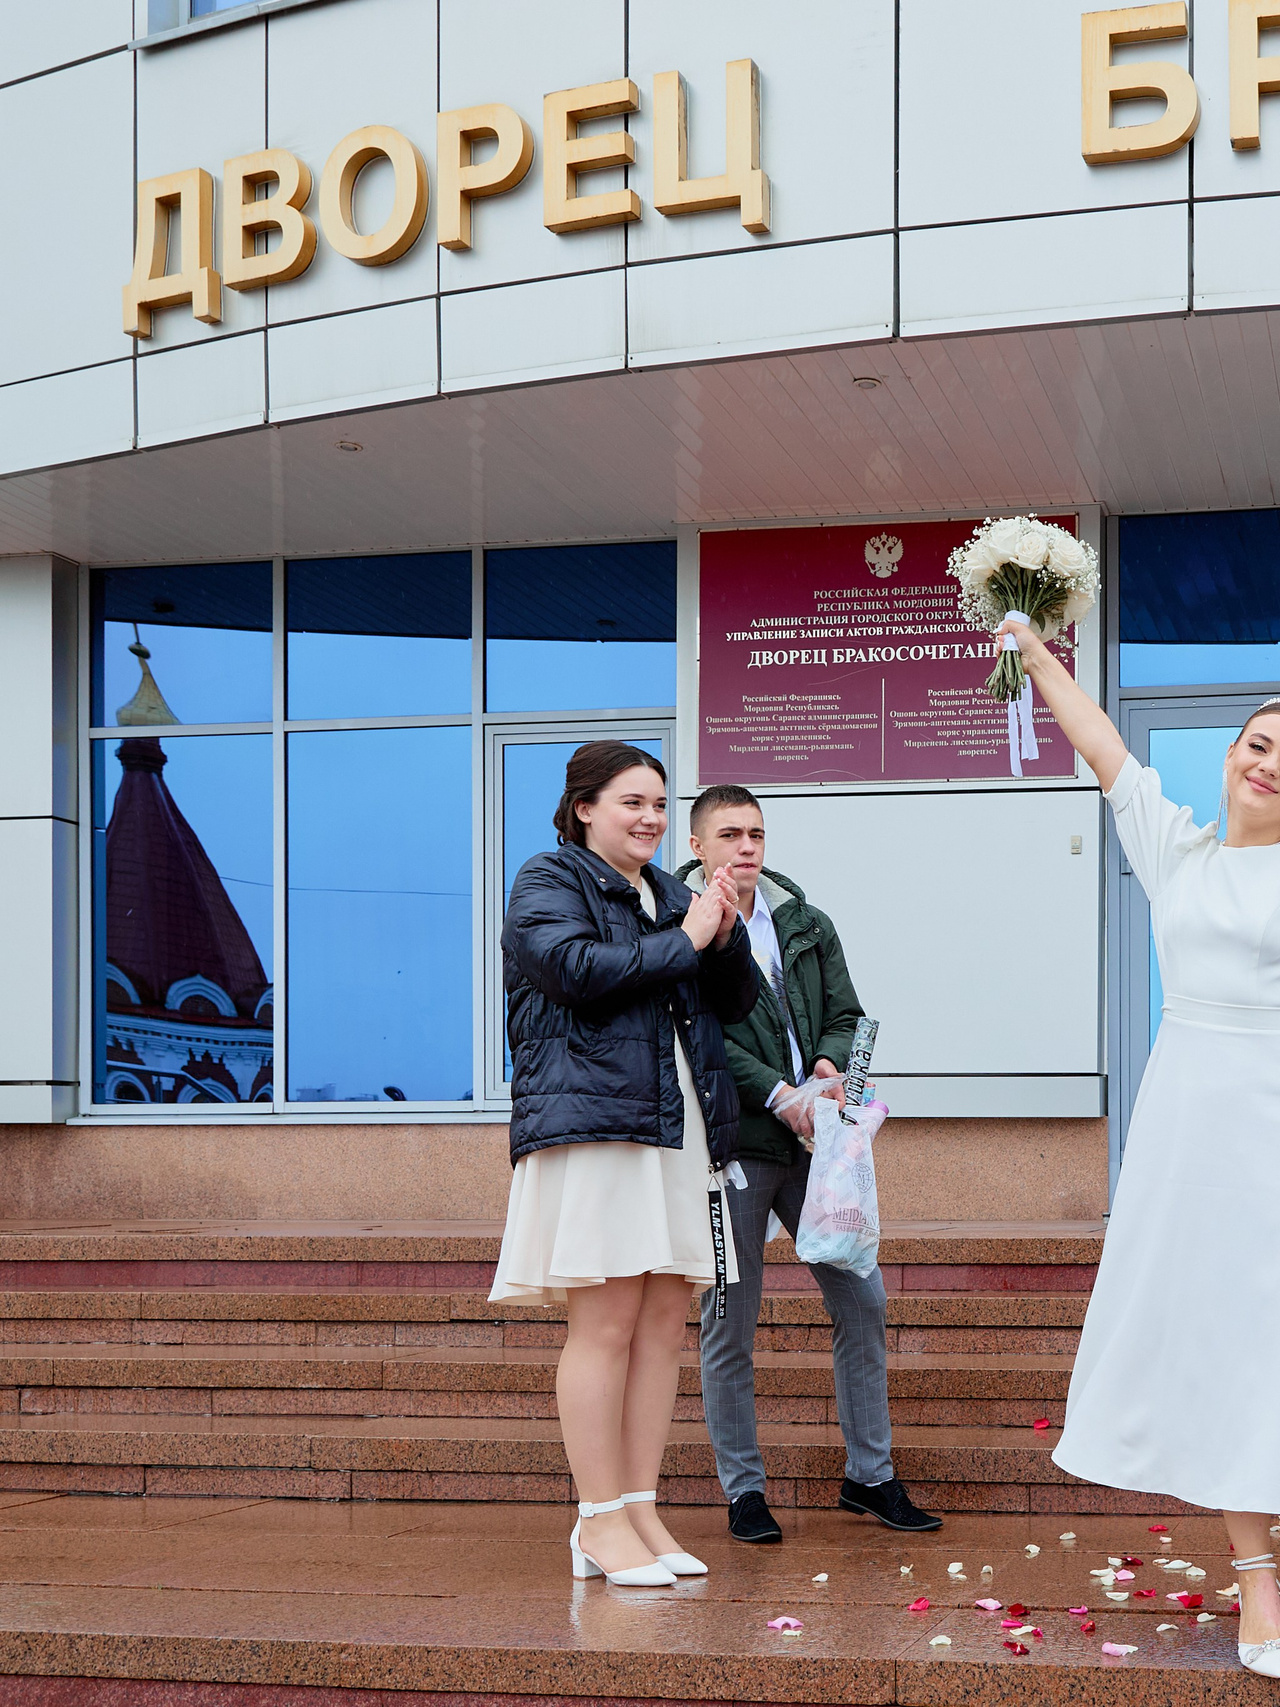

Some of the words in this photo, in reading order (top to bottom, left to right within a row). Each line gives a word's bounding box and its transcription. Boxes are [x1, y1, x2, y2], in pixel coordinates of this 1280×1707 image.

[122, 57, 771, 339] ДВОРЕЦ
[813, 587, 889, 599] РОССИЙСКАЯ
[891, 584, 957, 597] ФЕДЕРАЦИЯ
[817, 600, 890, 612] РЕСПУБЛИКА
[893, 598, 954, 609] МОРДОВИЯ
[750, 615, 848, 628] АДМИНИСТРАЦИЯ
[851, 612, 923, 624] ГОРОДСКОГО
[925, 610, 964, 621] ОКРУГ
[726, 630, 797, 642] УПРАВЛЕНИЕ
[799, 628, 844, 639] ЗАПИСИ
[846, 626, 883, 637] АКТОВ
[885, 623, 975, 636] ГРАЖДАНСКОГО
[747, 648, 828, 669] ДВОРЕЦ
[711, 1202, 725, 1274] YLM-ASYLM
